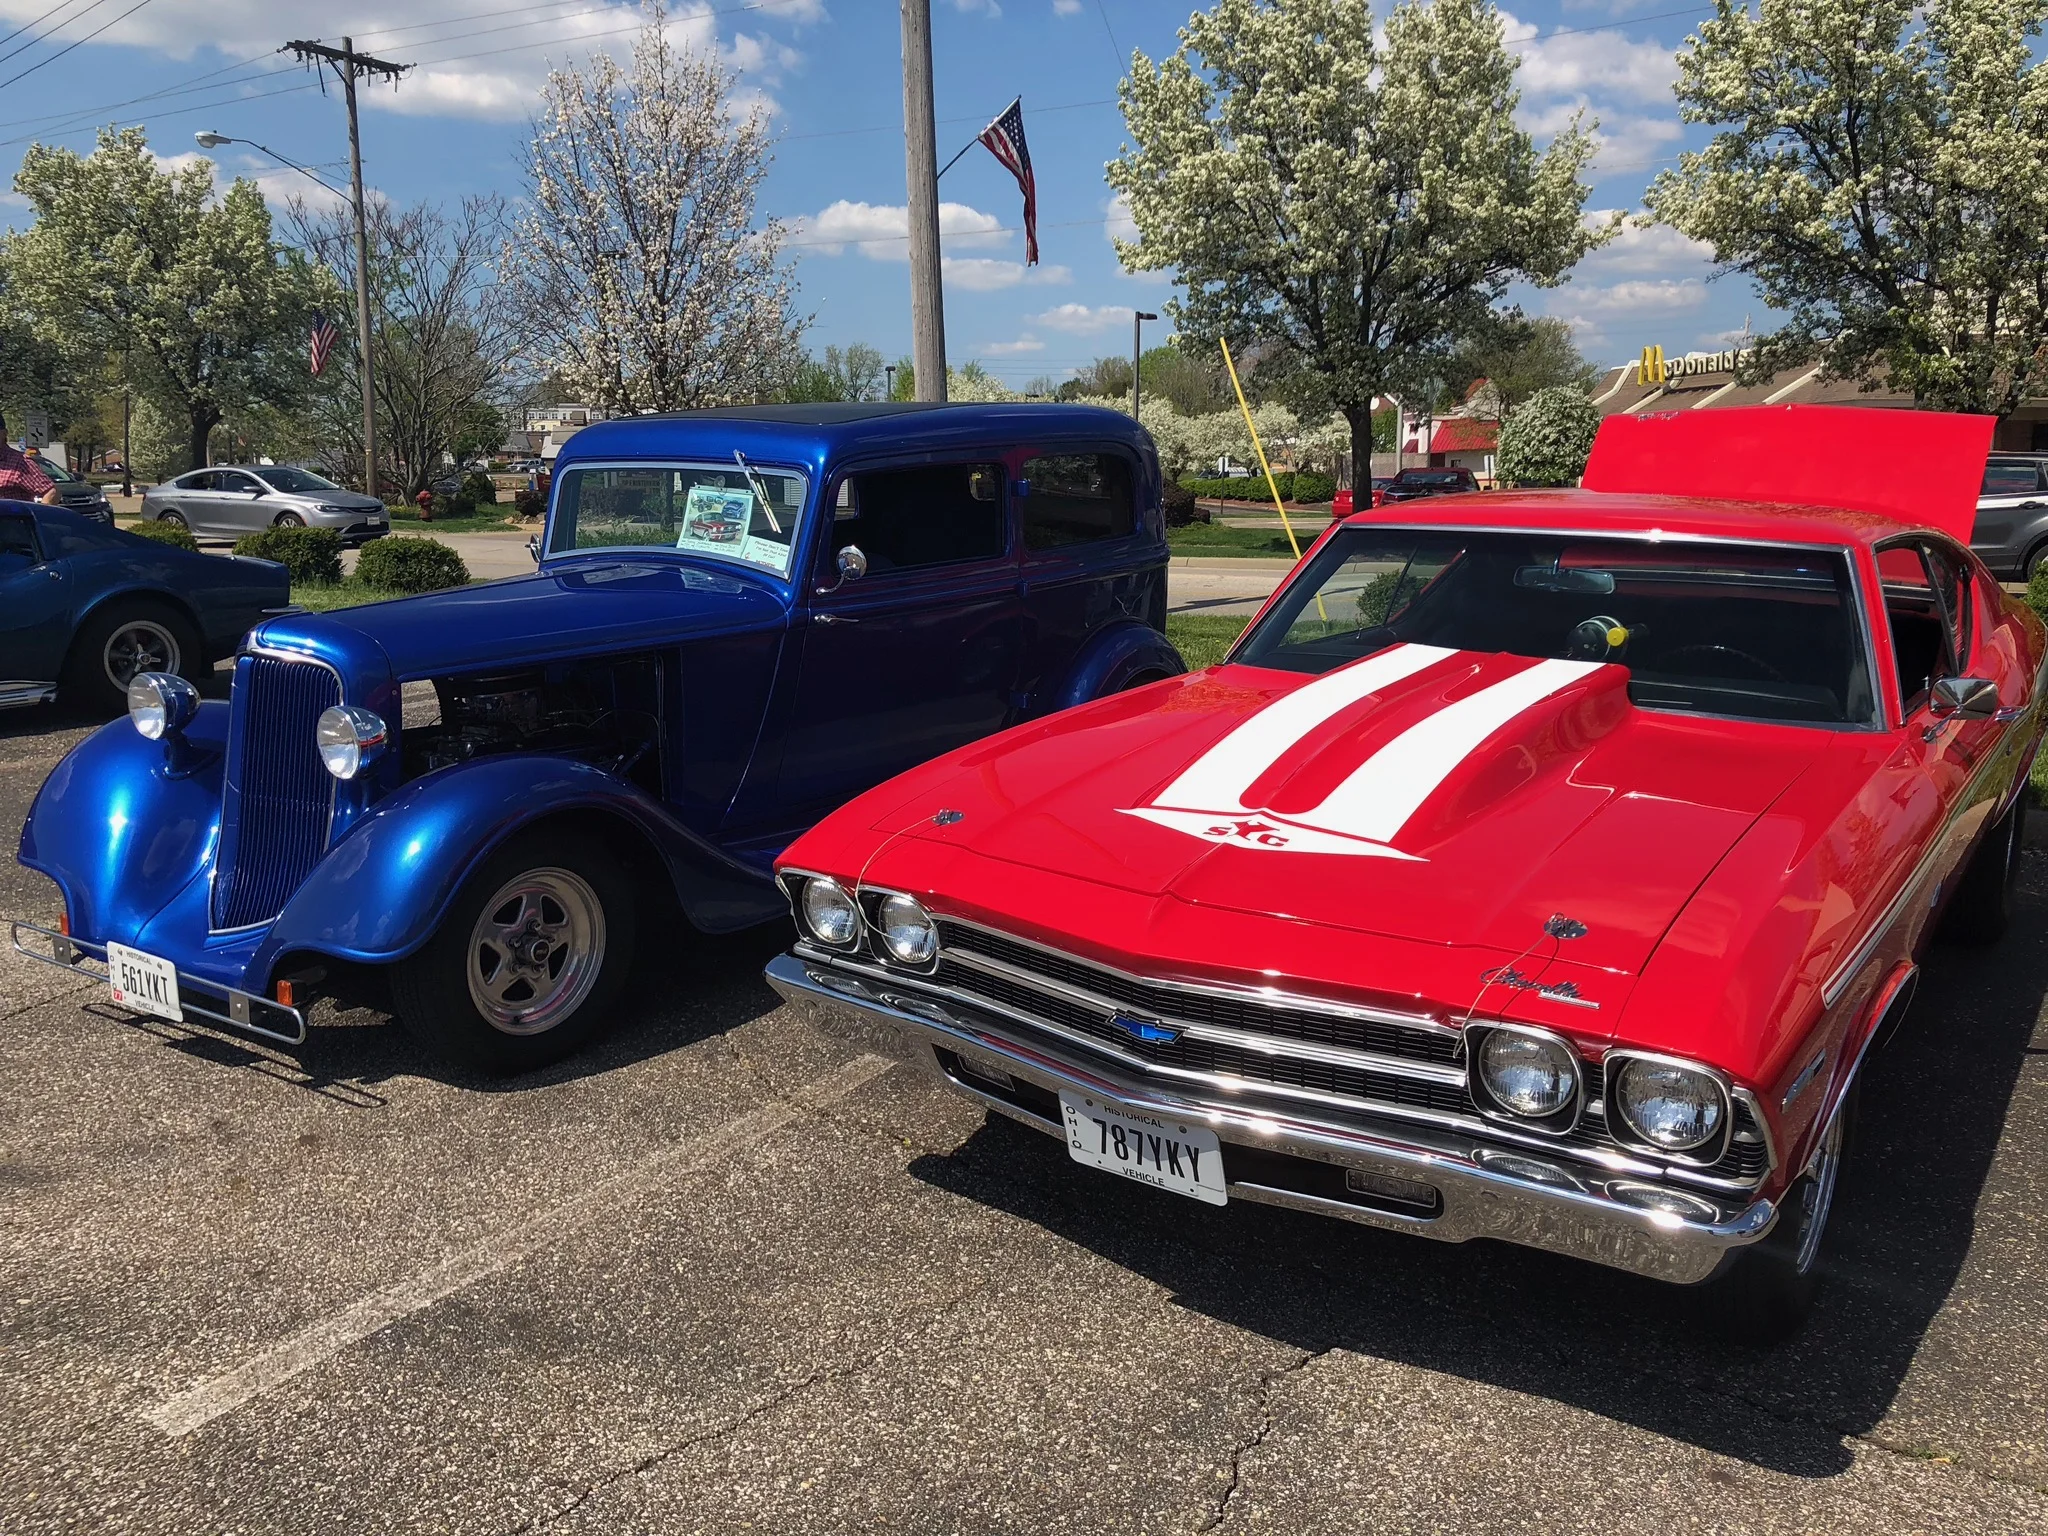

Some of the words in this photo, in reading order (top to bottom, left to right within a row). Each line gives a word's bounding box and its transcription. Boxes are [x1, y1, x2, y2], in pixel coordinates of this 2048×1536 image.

[1637, 344, 1748, 386] McDonald's
[109, 955, 118, 989] OHIO
[126, 950, 152, 965] HISTORICAL
[121, 962, 169, 1006] 561YKT
[135, 999, 155, 1012] VEHICLE
[1065, 1105, 1082, 1149] OHIO
[1104, 1105, 1164, 1129] HISTORICAL
[1092, 1117, 1200, 1183] 787YKY
[1122, 1166, 1164, 1187] VEHICLE
